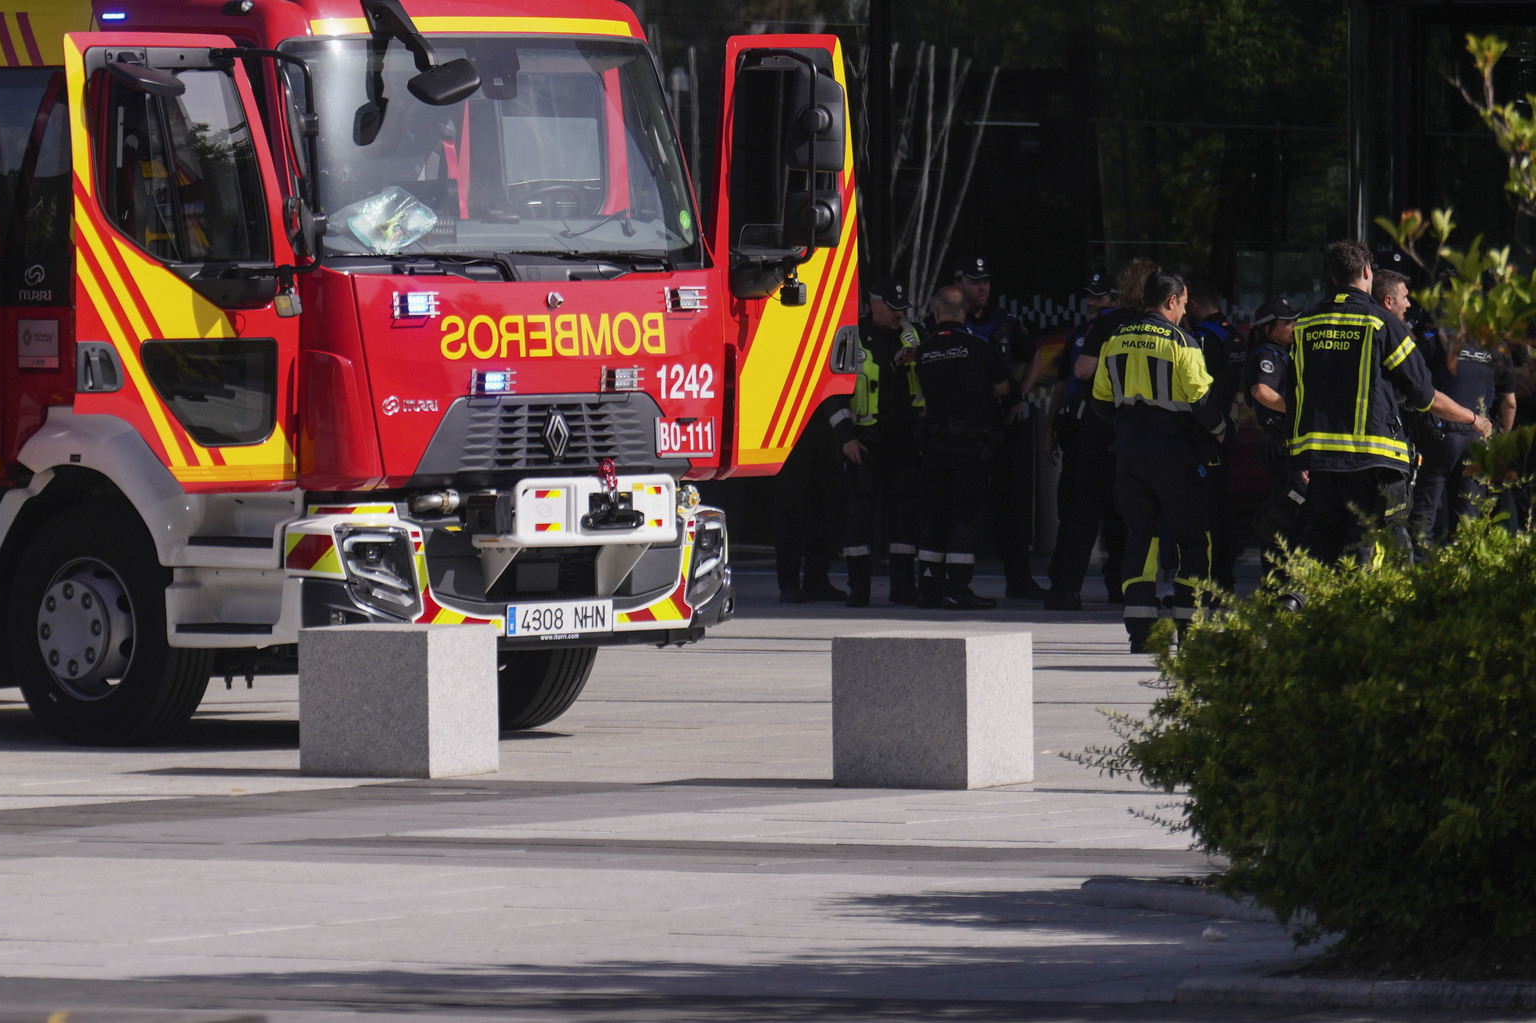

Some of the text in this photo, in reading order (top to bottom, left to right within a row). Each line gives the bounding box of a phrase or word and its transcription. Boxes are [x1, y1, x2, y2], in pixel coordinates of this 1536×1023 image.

[18, 289, 52, 301] ITURRI
[1306, 329, 1361, 341] BOMBEROS
[1121, 340, 1156, 350] MADRID
[1312, 340, 1350, 351] MADRID
[656, 363, 714, 399] 1242
[660, 421, 712, 451] BO-111
[522, 606, 605, 631] 4308 NHN
[540, 633, 580, 641] www.iturri.com
